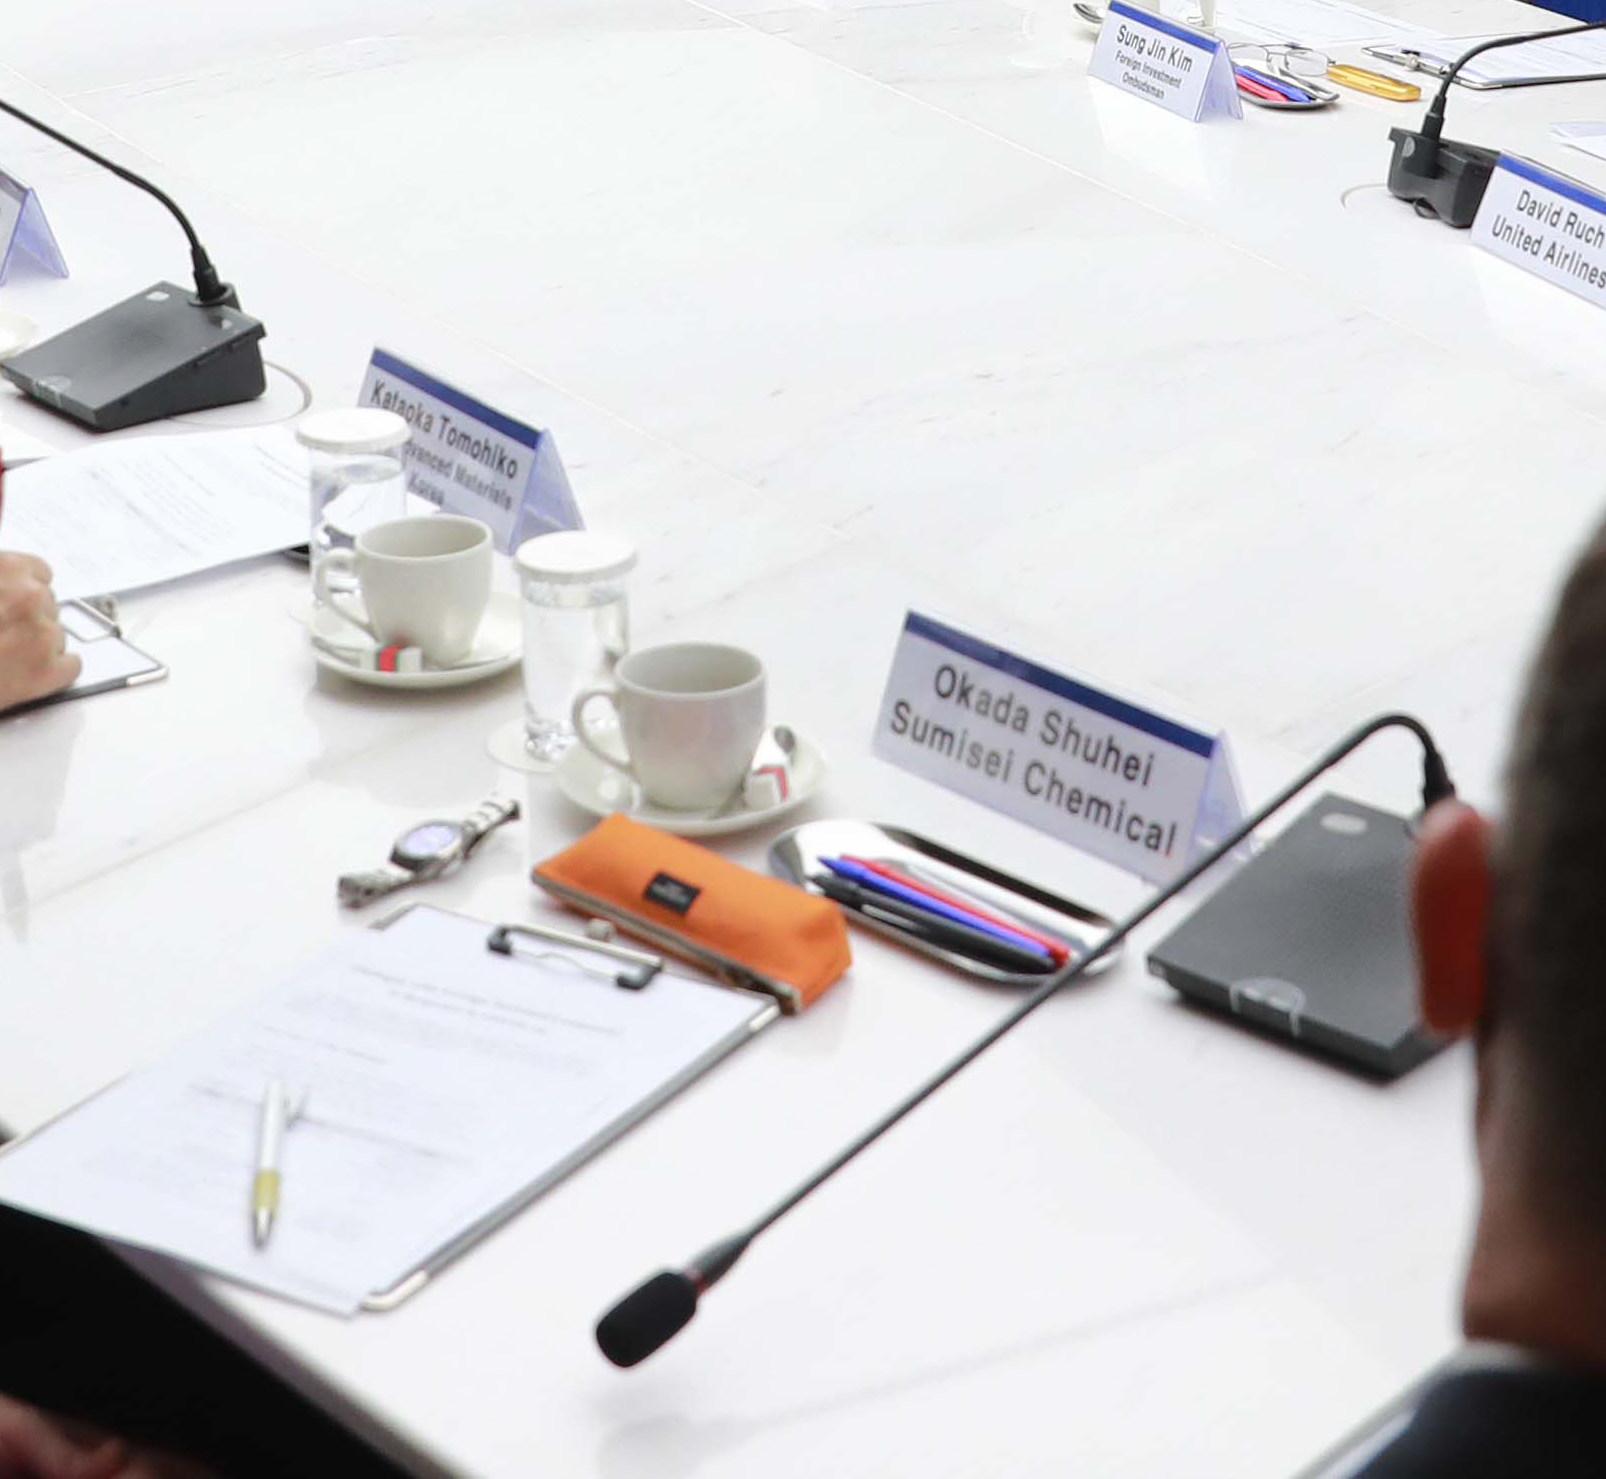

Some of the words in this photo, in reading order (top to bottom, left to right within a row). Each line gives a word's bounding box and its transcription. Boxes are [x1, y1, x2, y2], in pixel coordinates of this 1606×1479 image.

[1114, 49, 1142, 73] Foreign
[1116, 24, 1146, 55] Sung
[1147, 38, 1166, 63] Jin
[1167, 45, 1193, 73] Kim
[1491, 214, 1544, 257] United
[1516, 189, 1564, 229] David
[1563, 211, 1606, 250] Ruch
[370, 378, 435, 436] Kataoka
[437, 415, 520, 480] Tomohiko
[933, 664, 1030, 734] Okada
[1039, 709, 1155, 787] Shuhei
[890, 700, 1016, 784] Sumisei
[1023, 760, 1177, 858] Chemical
